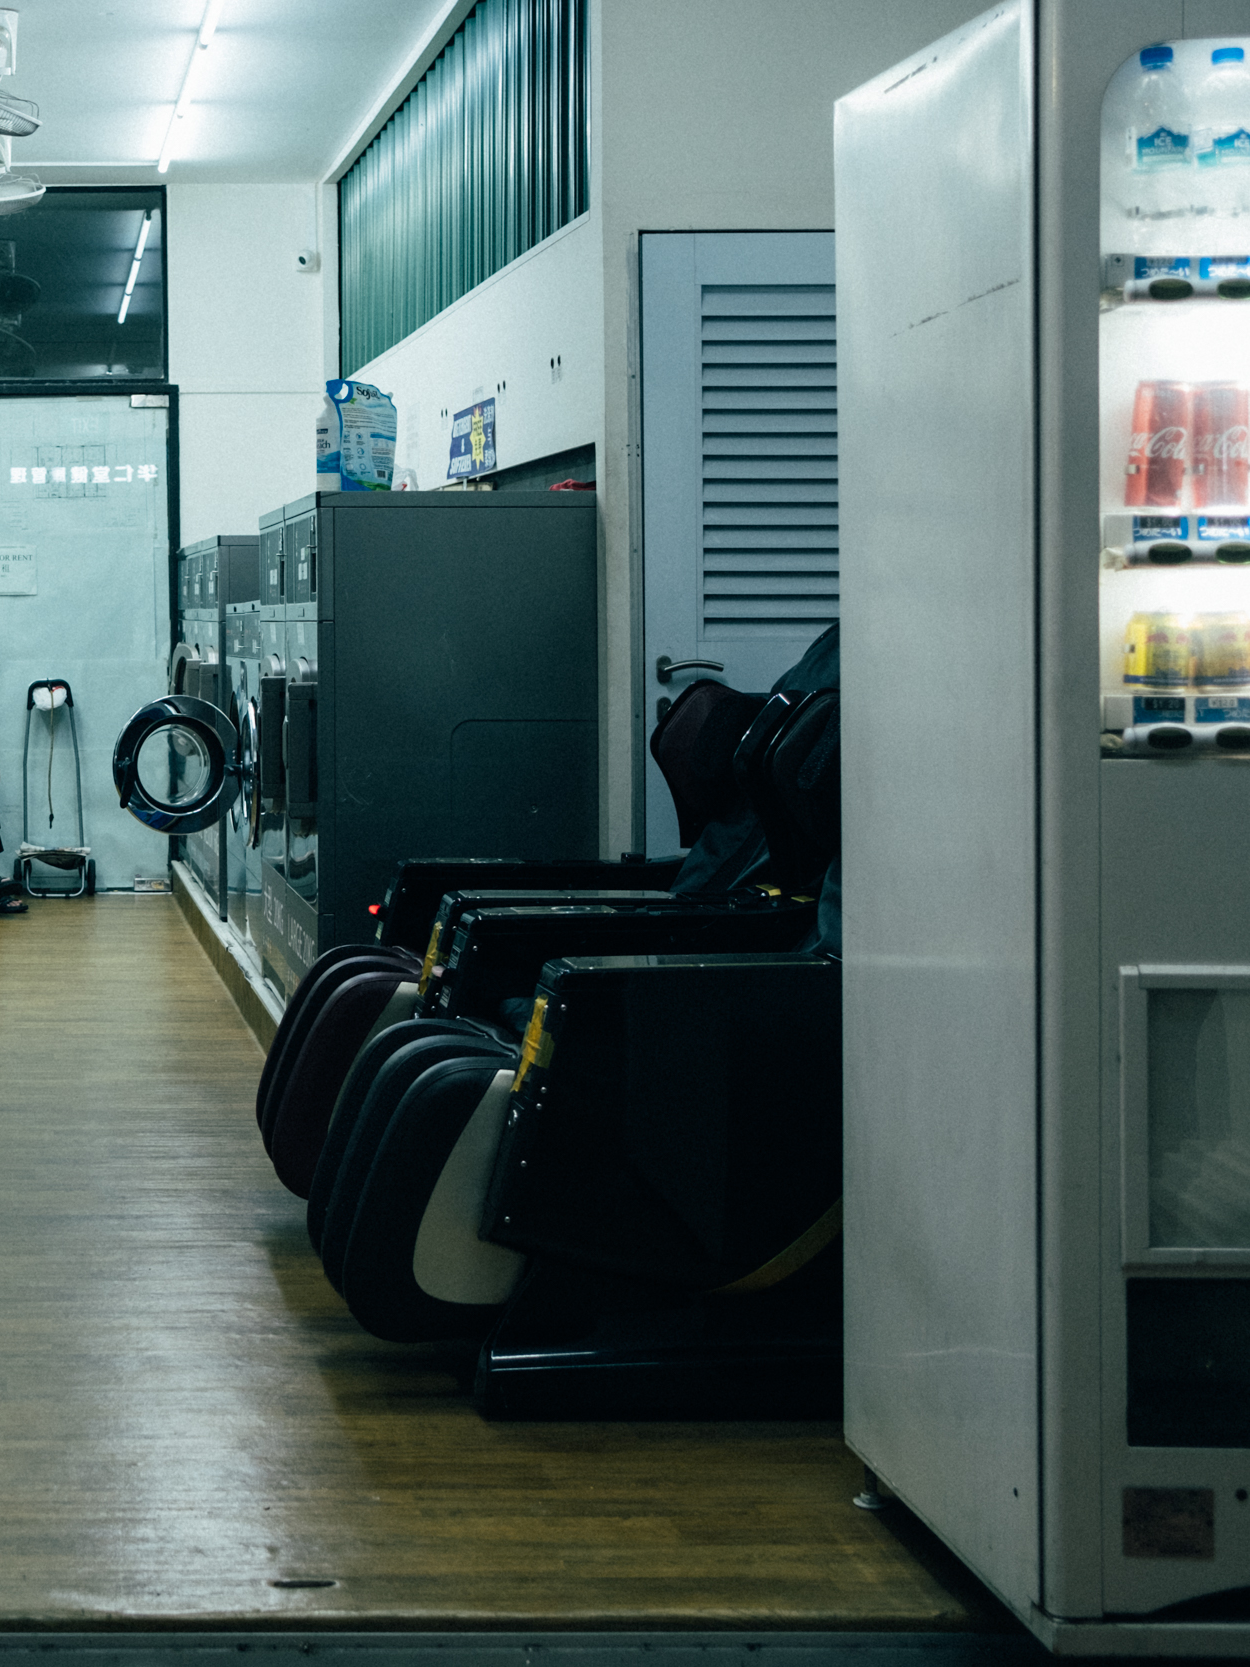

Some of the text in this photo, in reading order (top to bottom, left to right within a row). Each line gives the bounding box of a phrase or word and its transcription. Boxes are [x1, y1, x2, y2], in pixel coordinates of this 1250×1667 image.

[1154, 137, 1172, 146] ICE
[12, 554, 33, 562] RENT
[288, 914, 303, 960] LARGE
